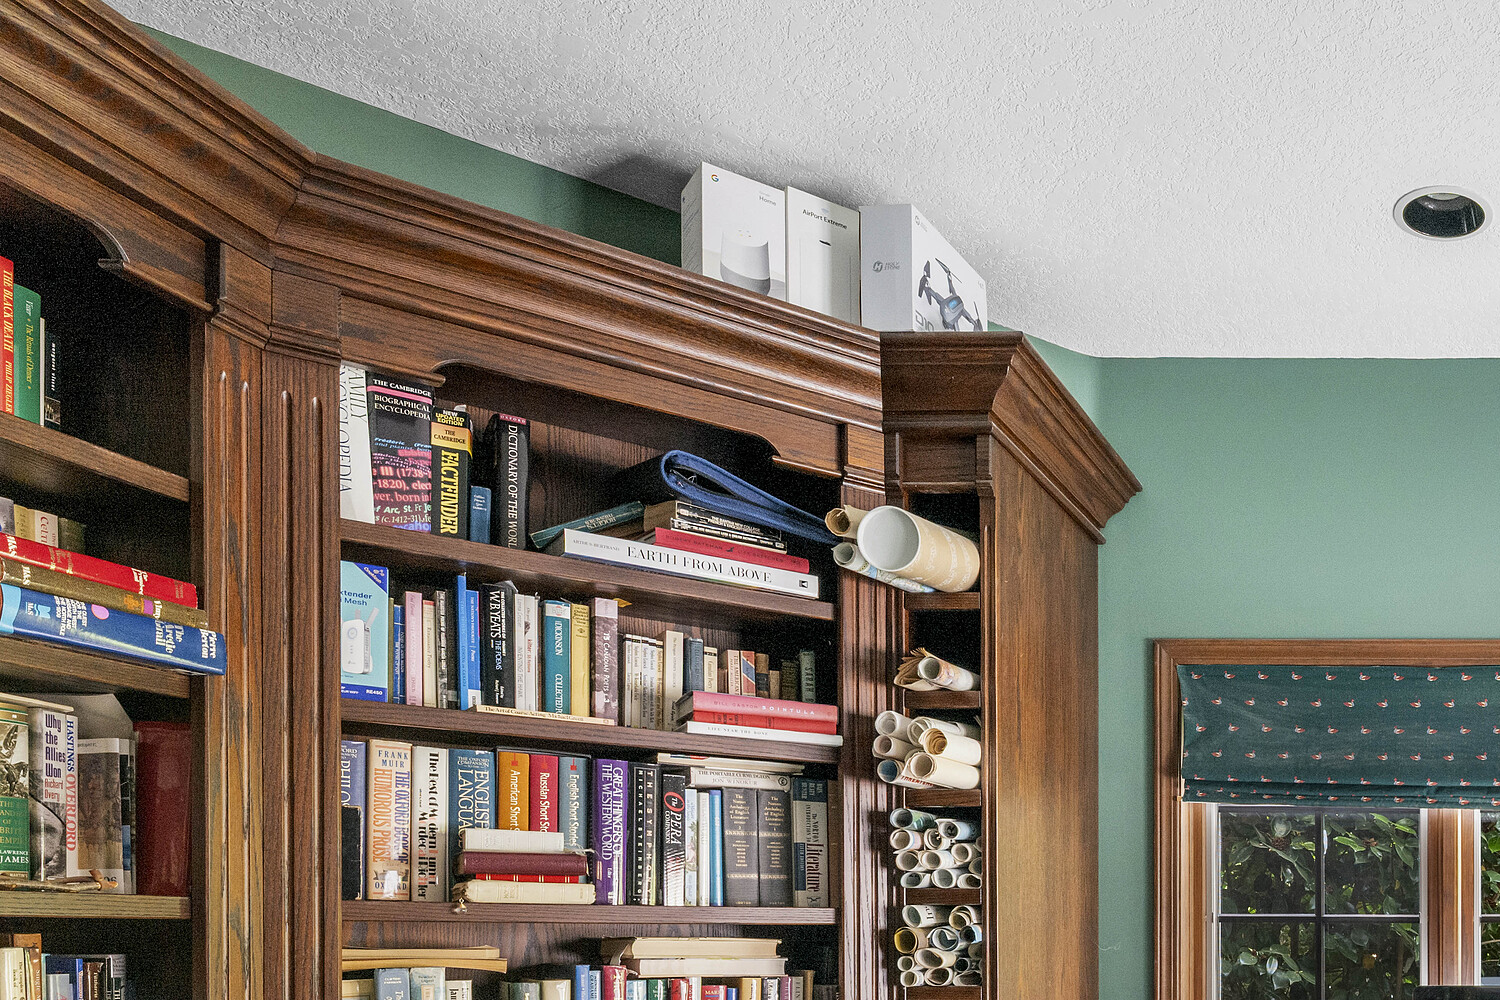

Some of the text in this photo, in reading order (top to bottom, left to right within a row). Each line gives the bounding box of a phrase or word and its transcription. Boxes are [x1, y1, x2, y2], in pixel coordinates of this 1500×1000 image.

[759, 195, 777, 207] Home
[802, 208, 848, 230] AirPort Extreme
[373, 378, 432, 397] THE CAMBRIDGE
[374, 394, 431, 412] BIOGRAPHICAL
[374, 403, 432, 421] ENCYCLOPEDIA
[434, 434, 466, 444] CAMBRIDGE
[440, 450, 459, 535] FACTFINDER
[626, 546, 772, 583] EARTH FROM ABOVE
[199, 628, 209, 659] Berton
[207, 630, 217, 659] Pierre
[762, 705, 816, 716] SOINTULA
[45, 713, 62, 733] Why
[45, 731, 58, 745] the
[45, 747, 66, 763] Allies
[378, 750, 409, 760] FRANK
[381, 759, 405, 768] MUIR
[45, 763, 62, 778] Won
[45, 778, 64, 790] Richard
[65, 720, 77, 851] HASTINGS OVERLORD
[510, 770, 521, 827] American Short
[540, 773, 550, 823] Russian Short
[612, 767, 623, 841] GREAT THINKERS
[372, 768, 392, 863] HUMOROUS PROSE
[567, 774, 579, 847] English Short Stories
[602, 764, 612, 861] THE WESTERN WORLD
[0, 853, 29, 864] JAMES
